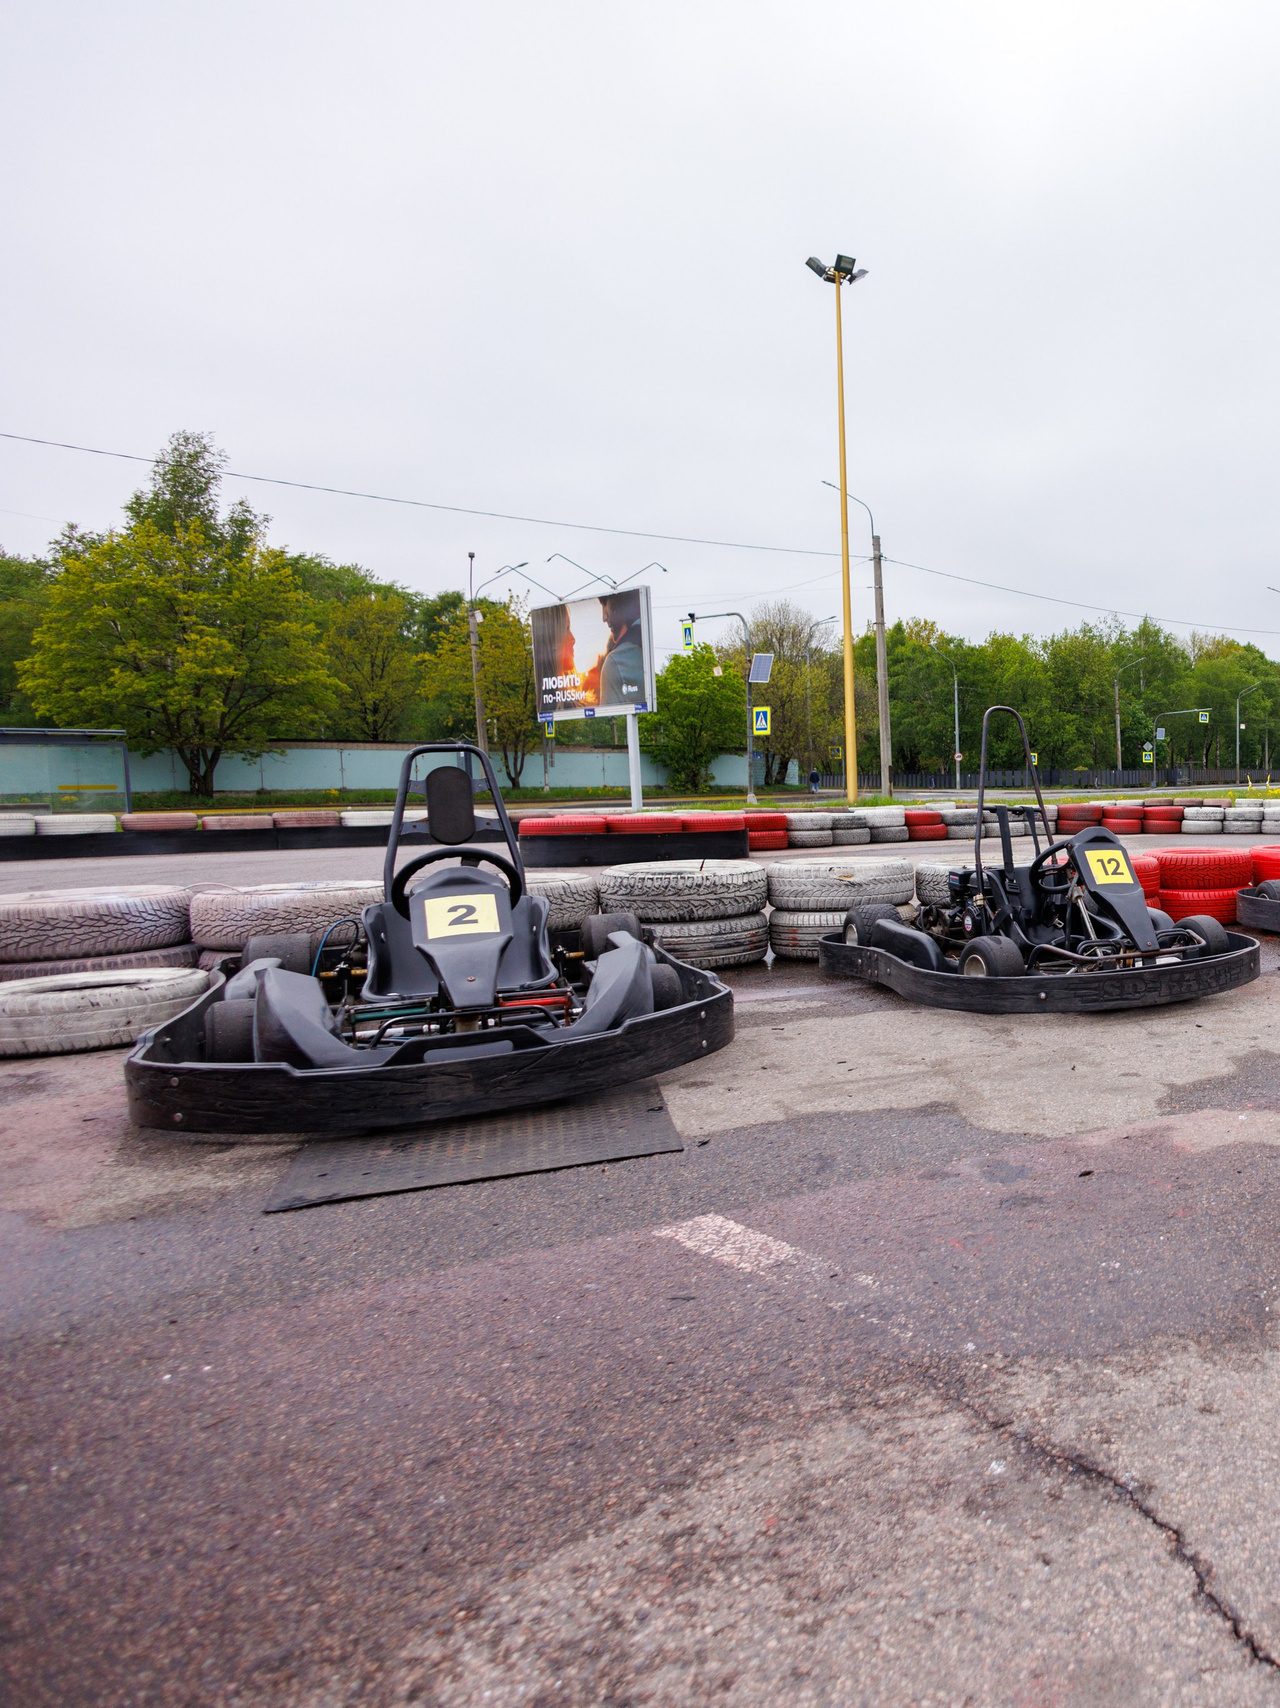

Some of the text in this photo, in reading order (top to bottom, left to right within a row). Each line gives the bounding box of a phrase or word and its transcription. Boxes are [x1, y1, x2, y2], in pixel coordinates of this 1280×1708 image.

[542, 674, 581, 690] ЛЮБИТЬ
[543, 690, 586, 703] по-RUSSки
[1096, 857, 1124, 876] 12
[447, 904, 479, 926] 2
